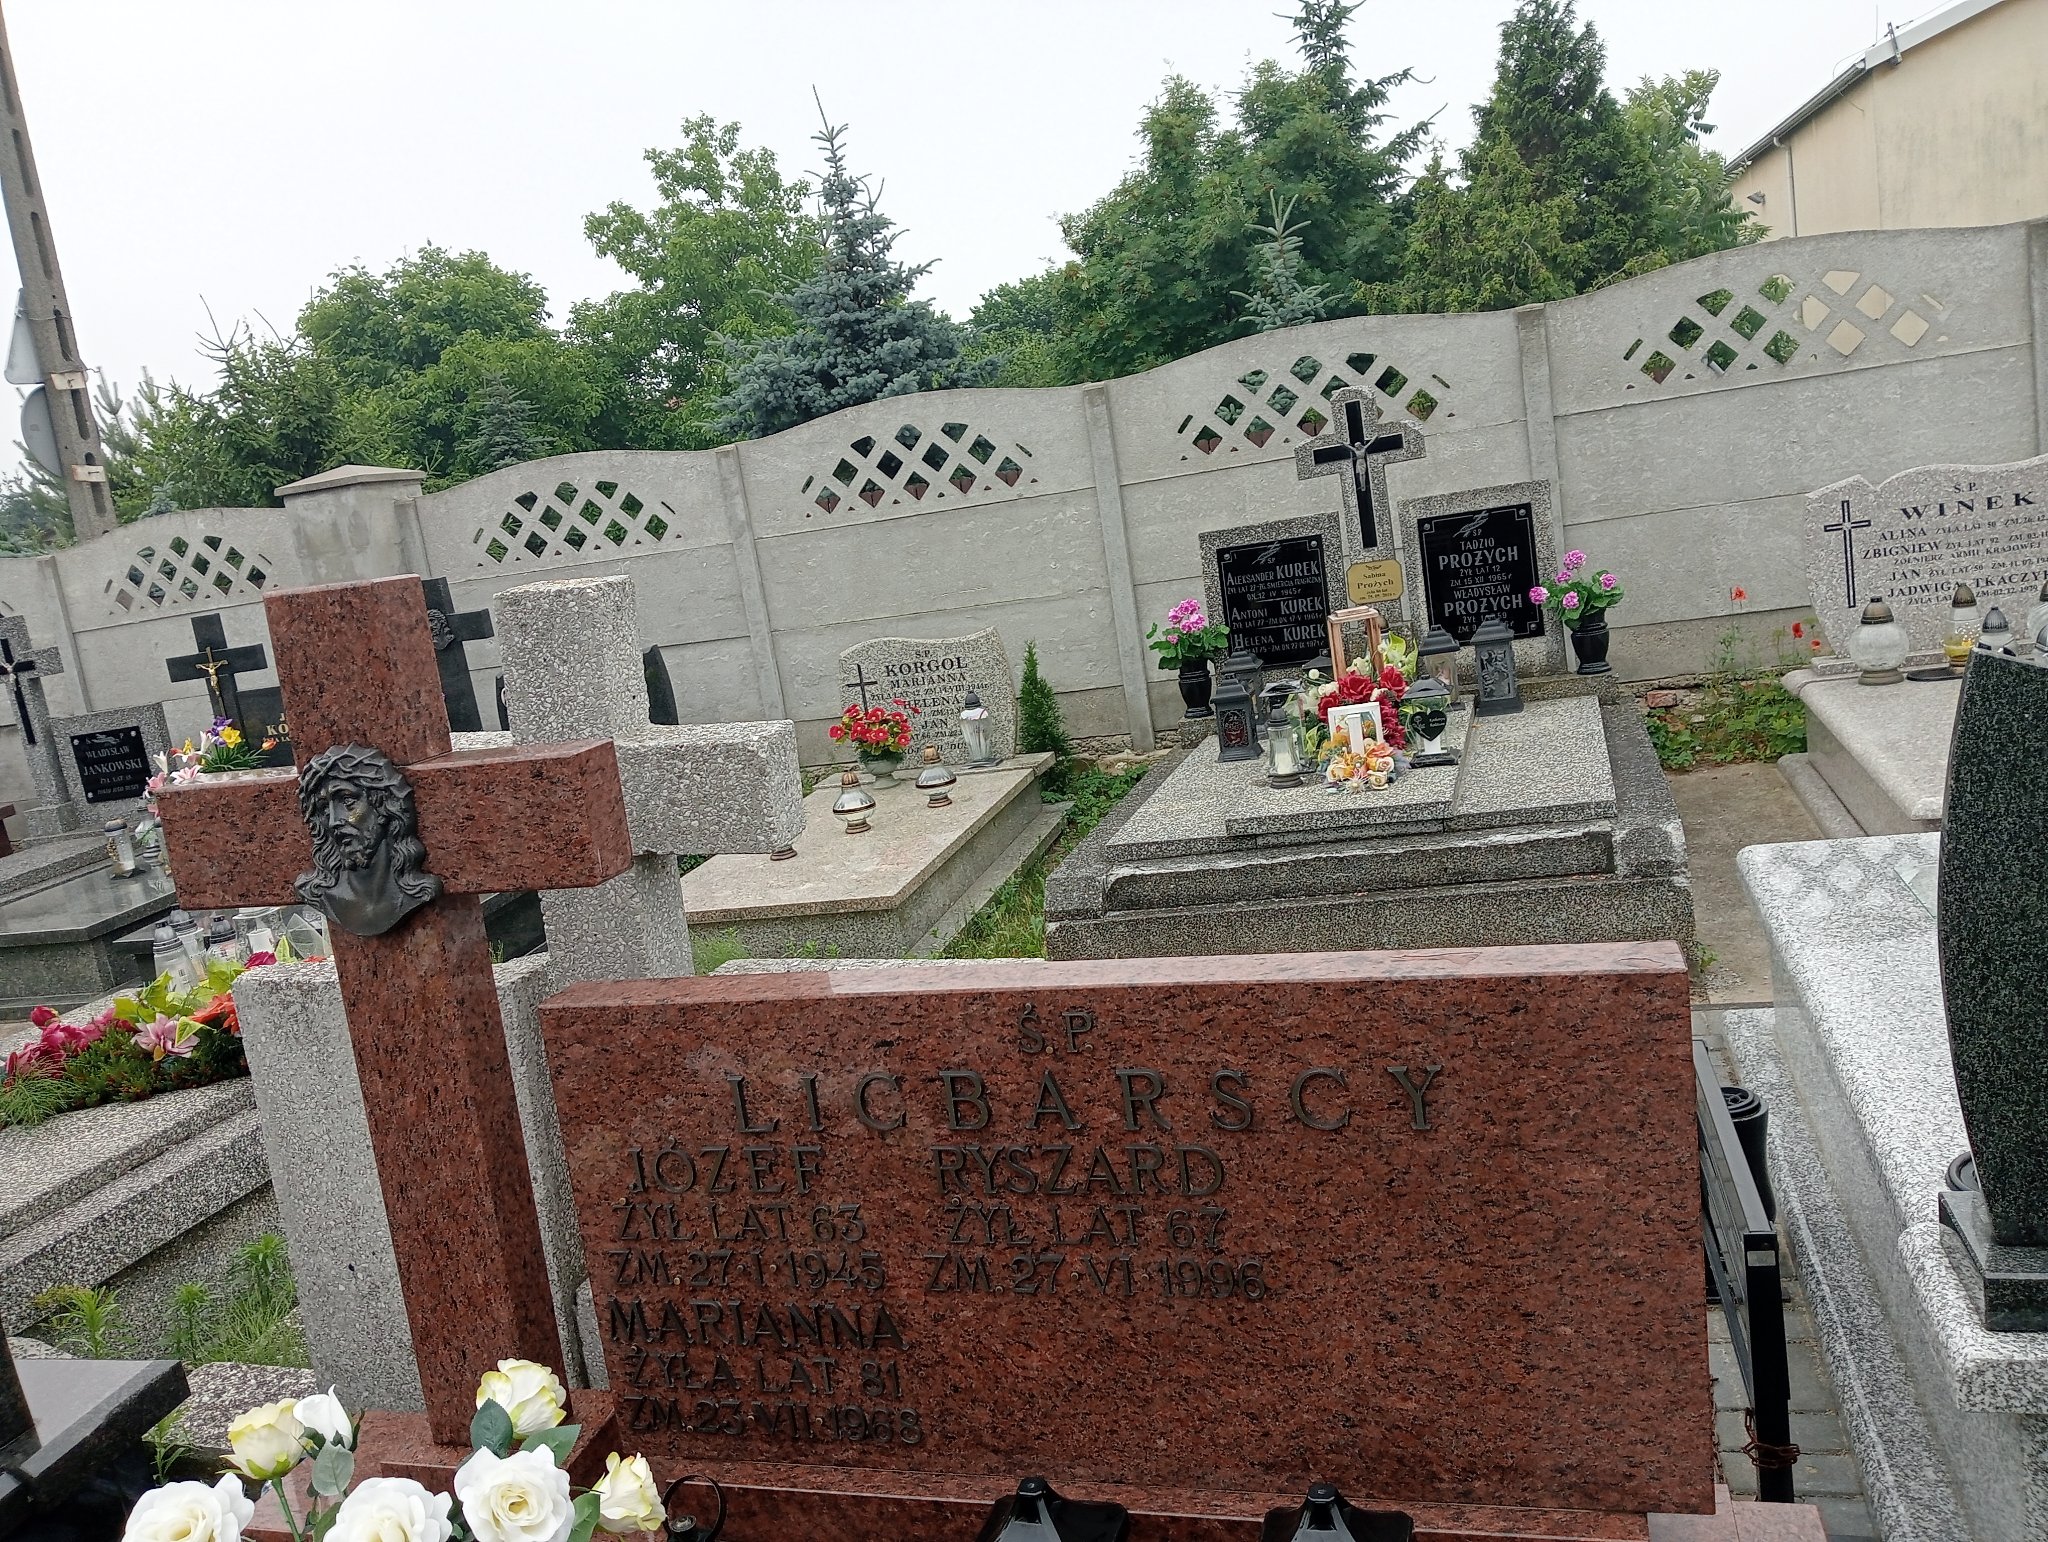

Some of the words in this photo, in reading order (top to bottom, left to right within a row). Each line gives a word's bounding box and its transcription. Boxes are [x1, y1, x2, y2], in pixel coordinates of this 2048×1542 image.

[1899, 490, 2039, 521] WINEK
[1459, 537, 1495, 551] TADZIO
[1878, 527, 1927, 541] ALINA
[1438, 546, 1518, 571] PROŻYCH
[1862, 540, 1941, 560] ZBIGNIEW
[1968, 538, 1986, 547] LAT
[1950, 549, 1979, 559] ARMII
[1985, 541, 2041, 555] KRAJOWEJ
[1226, 571, 1275, 587] ALEKSANDER
[1276, 560, 1320, 580] KUREK
[1475, 566, 1489, 575] LAT
[1492, 564, 1501, 573] 12
[1888, 568, 1921, 582] JAN
[1357, 579, 1394, 590] Prożych
[1464, 577, 1473, 585] 15
[1887, 581, 1961, 598] JADWIGA
[1453, 584, 1511, 600] WŁADYSŁAW
[1231, 607, 1268, 621] ANTONI
[1280, 597, 1324, 615] KUREK
[1443, 593, 1523, 617] PROŻYCH
[1234, 633, 1275, 648] HELENA
[1283, 624, 1326, 642] KUREK
[884, 657, 968, 678] KORGOL
[890, 672, 967, 689] MARIANNA
[903, 694, 962, 710] HELENA
[921, 718, 948, 730] JAN
[85, 745, 130, 759] WŁADYSŁAW
[84, 758, 143, 776] JANKOWSKI
[726, 1064, 1444, 1134] LICBARSCY
[627, 1134, 824, 1195] JÓZEF
[930, 1143, 1226, 1197] RYSZARD
[706, 1201, 793, 1243] LAT
[811, 1202, 867, 1244] 63
[944, 1195, 1035, 1246] ŻYŁ
[1051, 1202, 1144, 1248] LAT
[1165, 1206, 1227, 1250] 67
[607, 1297, 910, 1351] MARIANNA
[624, 1344, 742, 1392] ŻYŁA
[753, 1354, 838, 1396] LAT
[860, 1358, 903, 1399] 81
